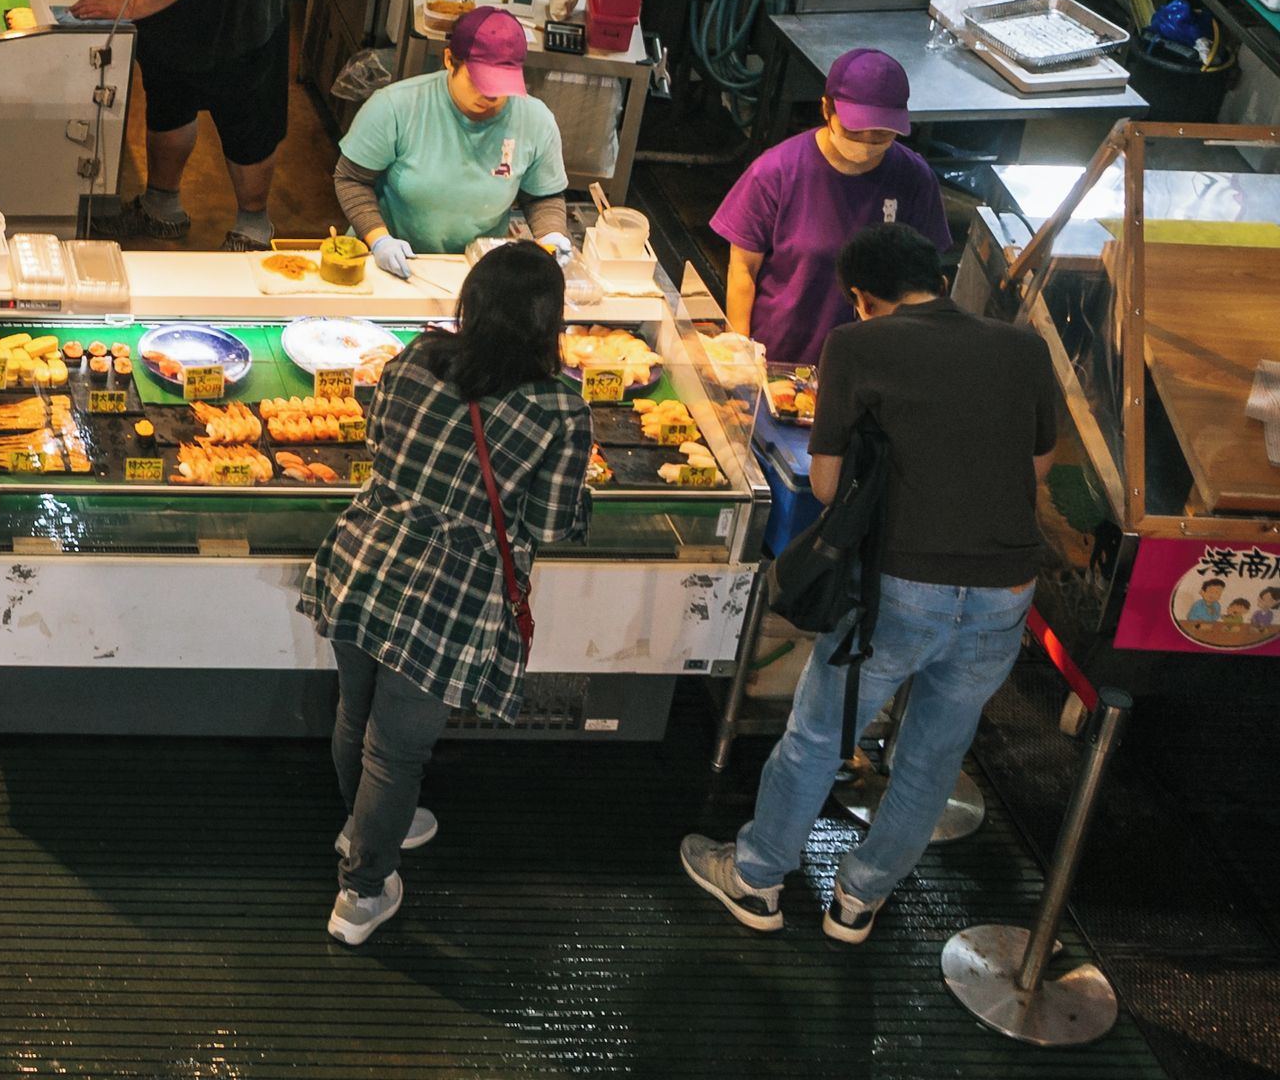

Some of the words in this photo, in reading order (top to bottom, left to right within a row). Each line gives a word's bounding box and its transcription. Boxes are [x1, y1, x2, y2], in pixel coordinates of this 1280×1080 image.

[320, 377, 351, 386] カマトロ
[129, 461, 161, 470] 特大ウニ
